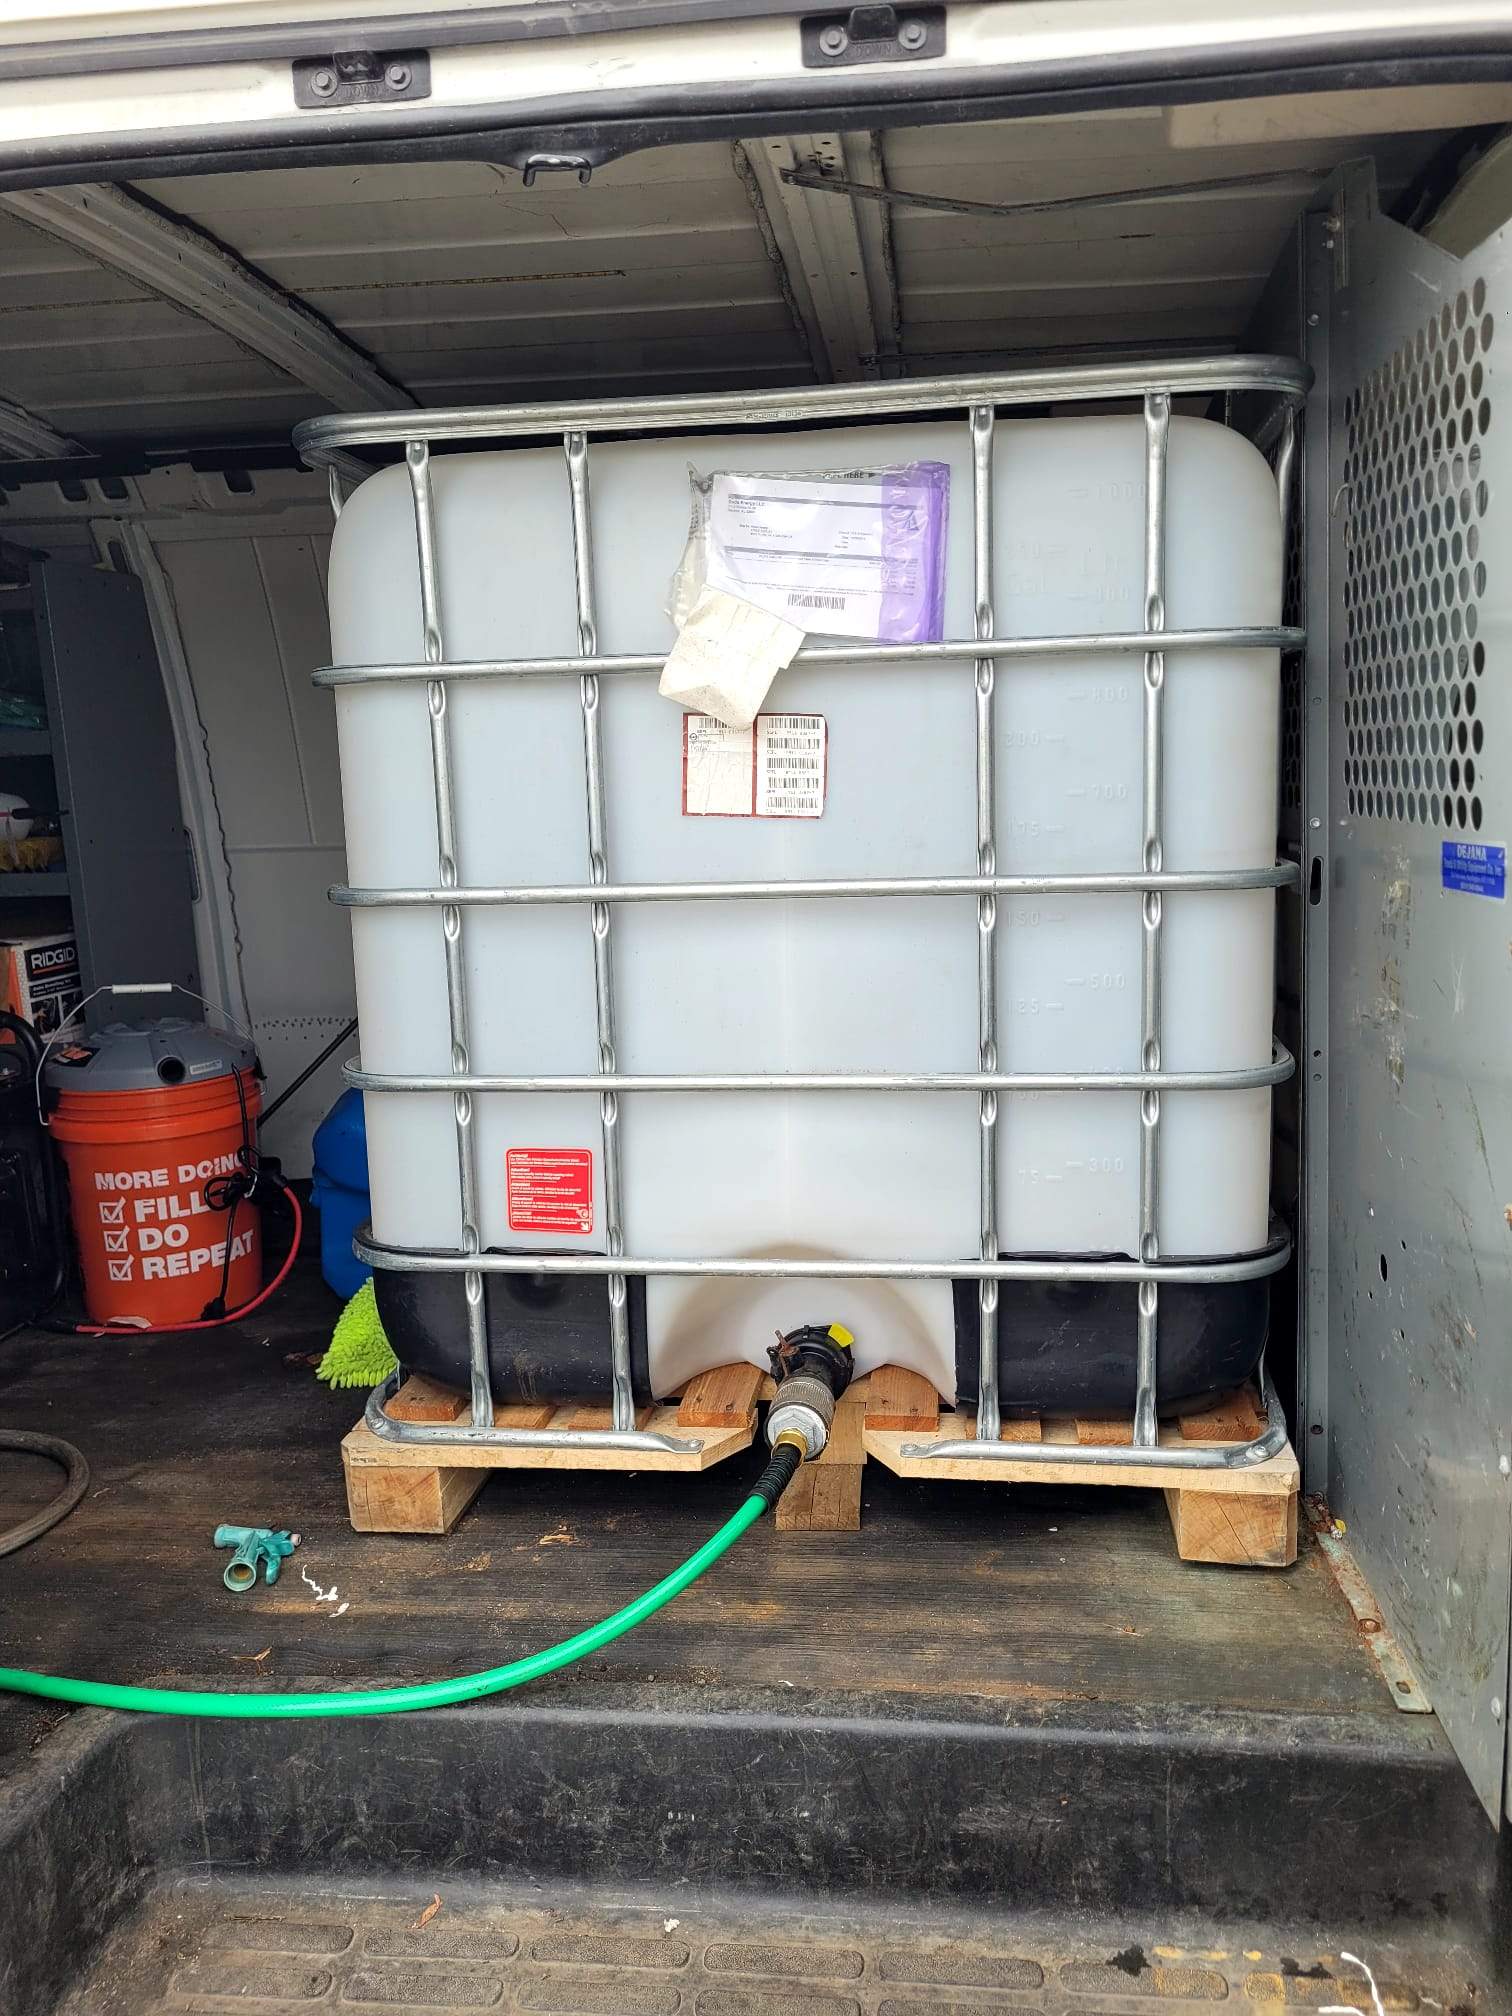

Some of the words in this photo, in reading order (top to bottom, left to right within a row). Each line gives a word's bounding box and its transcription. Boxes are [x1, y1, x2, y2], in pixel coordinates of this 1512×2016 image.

[30, 946, 76, 970] RIDGID
[94, 1168, 170, 1191] MORE
[134, 1191, 212, 1223] FILL
[137, 1223, 190, 1251] DO
[142, 1229, 254, 1280] REPEAT
